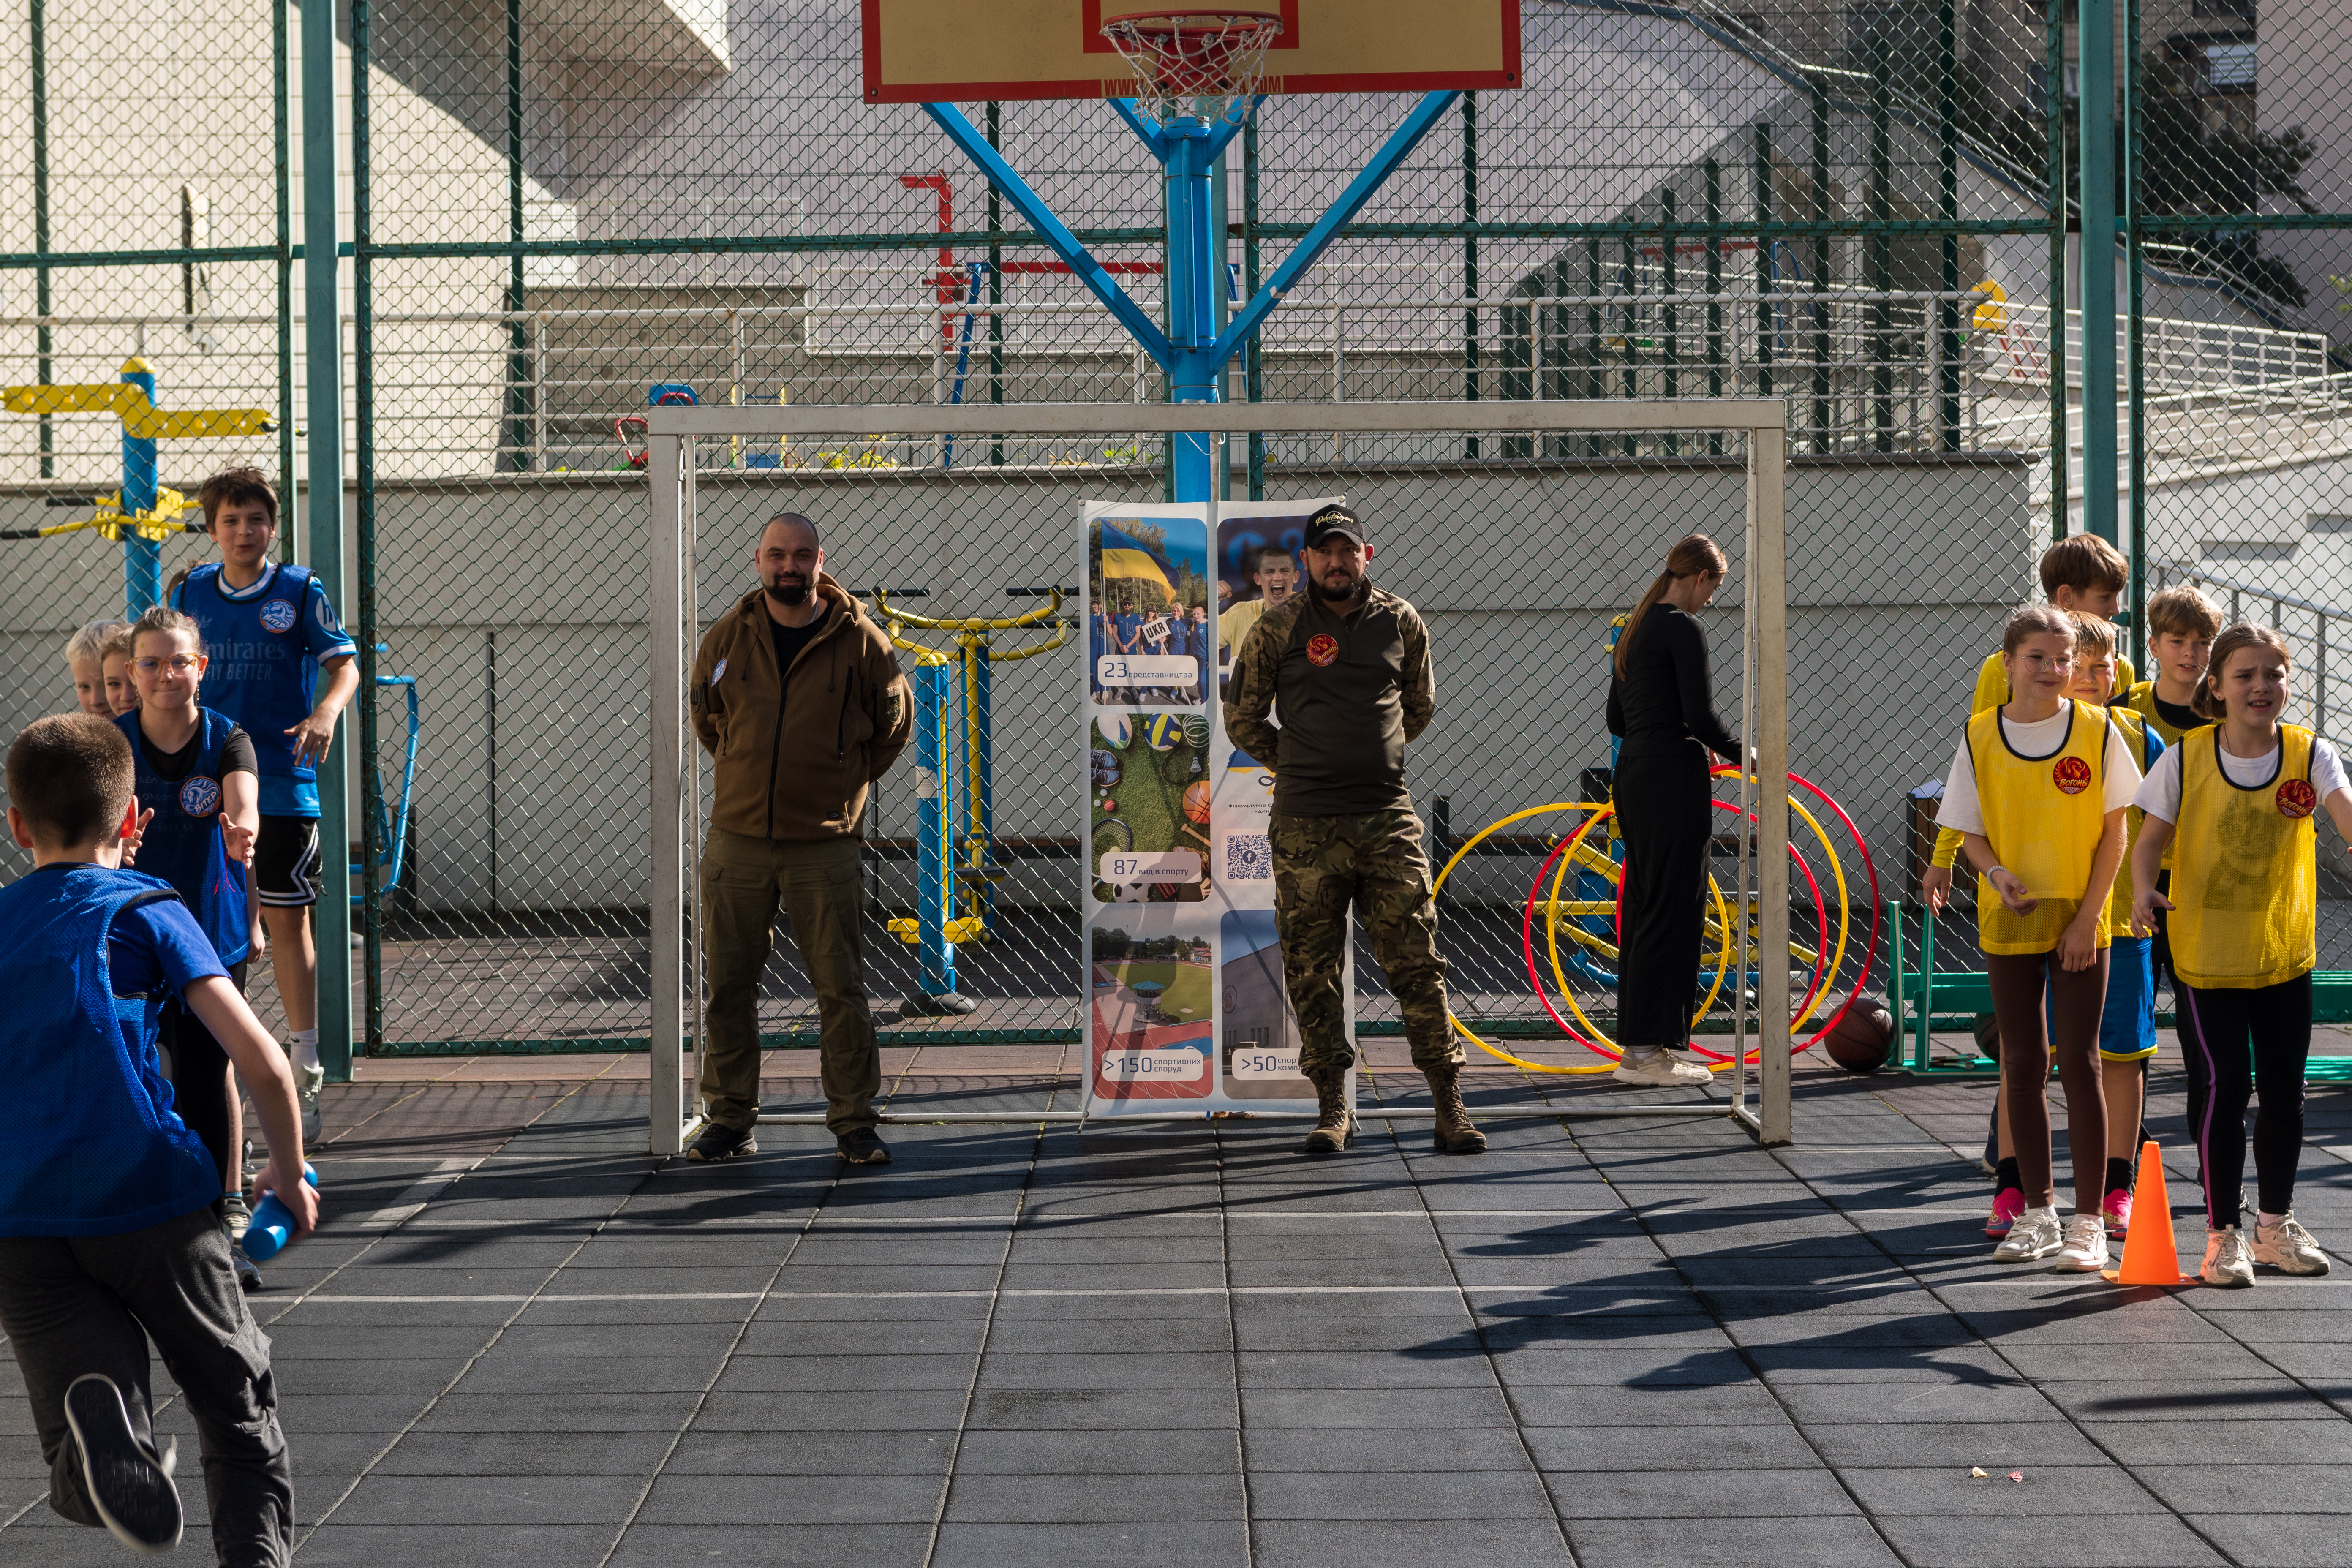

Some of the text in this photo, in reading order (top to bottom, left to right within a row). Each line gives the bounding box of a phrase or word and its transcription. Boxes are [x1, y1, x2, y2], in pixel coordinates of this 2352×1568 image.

[1316, 513, 1353, 527] Pentagon
[1146, 622, 1166, 638] UKR
[204, 638, 285, 660] mirates
[1317, 646, 1337, 664] ВОГОНЬ
[226, 663, 272, 681] BETTER
[1104, 662, 1127, 678] 23
[2058, 779, 2088, 787] ВОГОНЬ
[2277, 797, 2307, 815] ВОГОНЬ
[1114, 860, 1138, 874] 87
[1105, 1057, 1152, 1073] >150
[1242, 1056, 1276, 1071] >50
